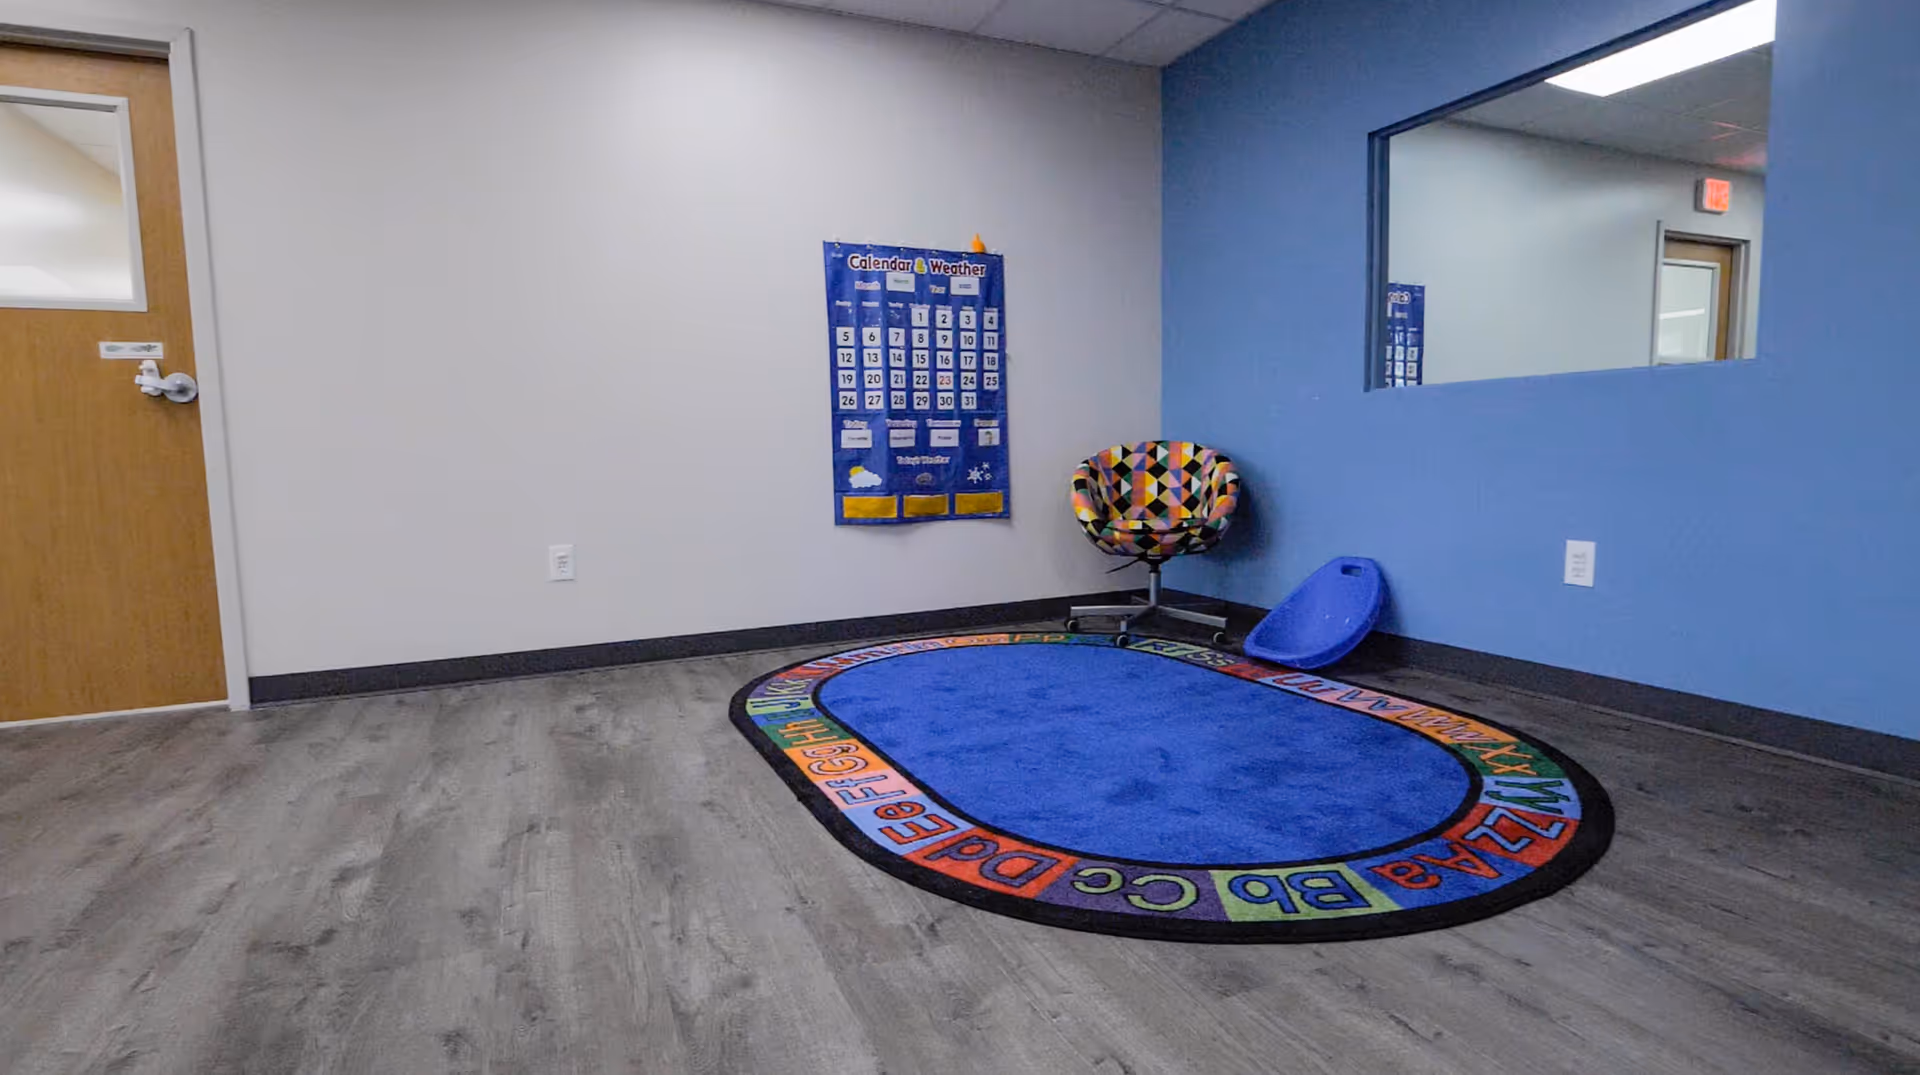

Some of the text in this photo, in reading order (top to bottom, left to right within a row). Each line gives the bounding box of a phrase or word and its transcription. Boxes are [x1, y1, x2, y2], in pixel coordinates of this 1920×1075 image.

[848, 253, 913, 272] Calendar
[929, 258, 987, 277] Weather
[917, 311, 994, 325] 1 2 3 4
[842, 331, 995, 346] 5 6 7 8 9 10 11
[841, 352, 997, 367] 12 13 14 15 16 17 18
[841, 373, 999, 387] 19 20 21 22 23 24 25
[841, 394, 975, 407] 26 27 28 29 30 31
[777, 719, 838, 747] Hh
[801, 743, 868, 775] Gg
[1460, 744, 1539, 776] Xx
[825, 775, 907, 806] Ff
[874, 801, 958, 845] Ee
[1463, 806, 1568, 853] Zz
[925, 836, 1063, 889] Dd
[1371, 843, 1501, 890] Aa
[1072, 867, 1200, 912] Cc
[1228, 871, 1372, 914] Bb
